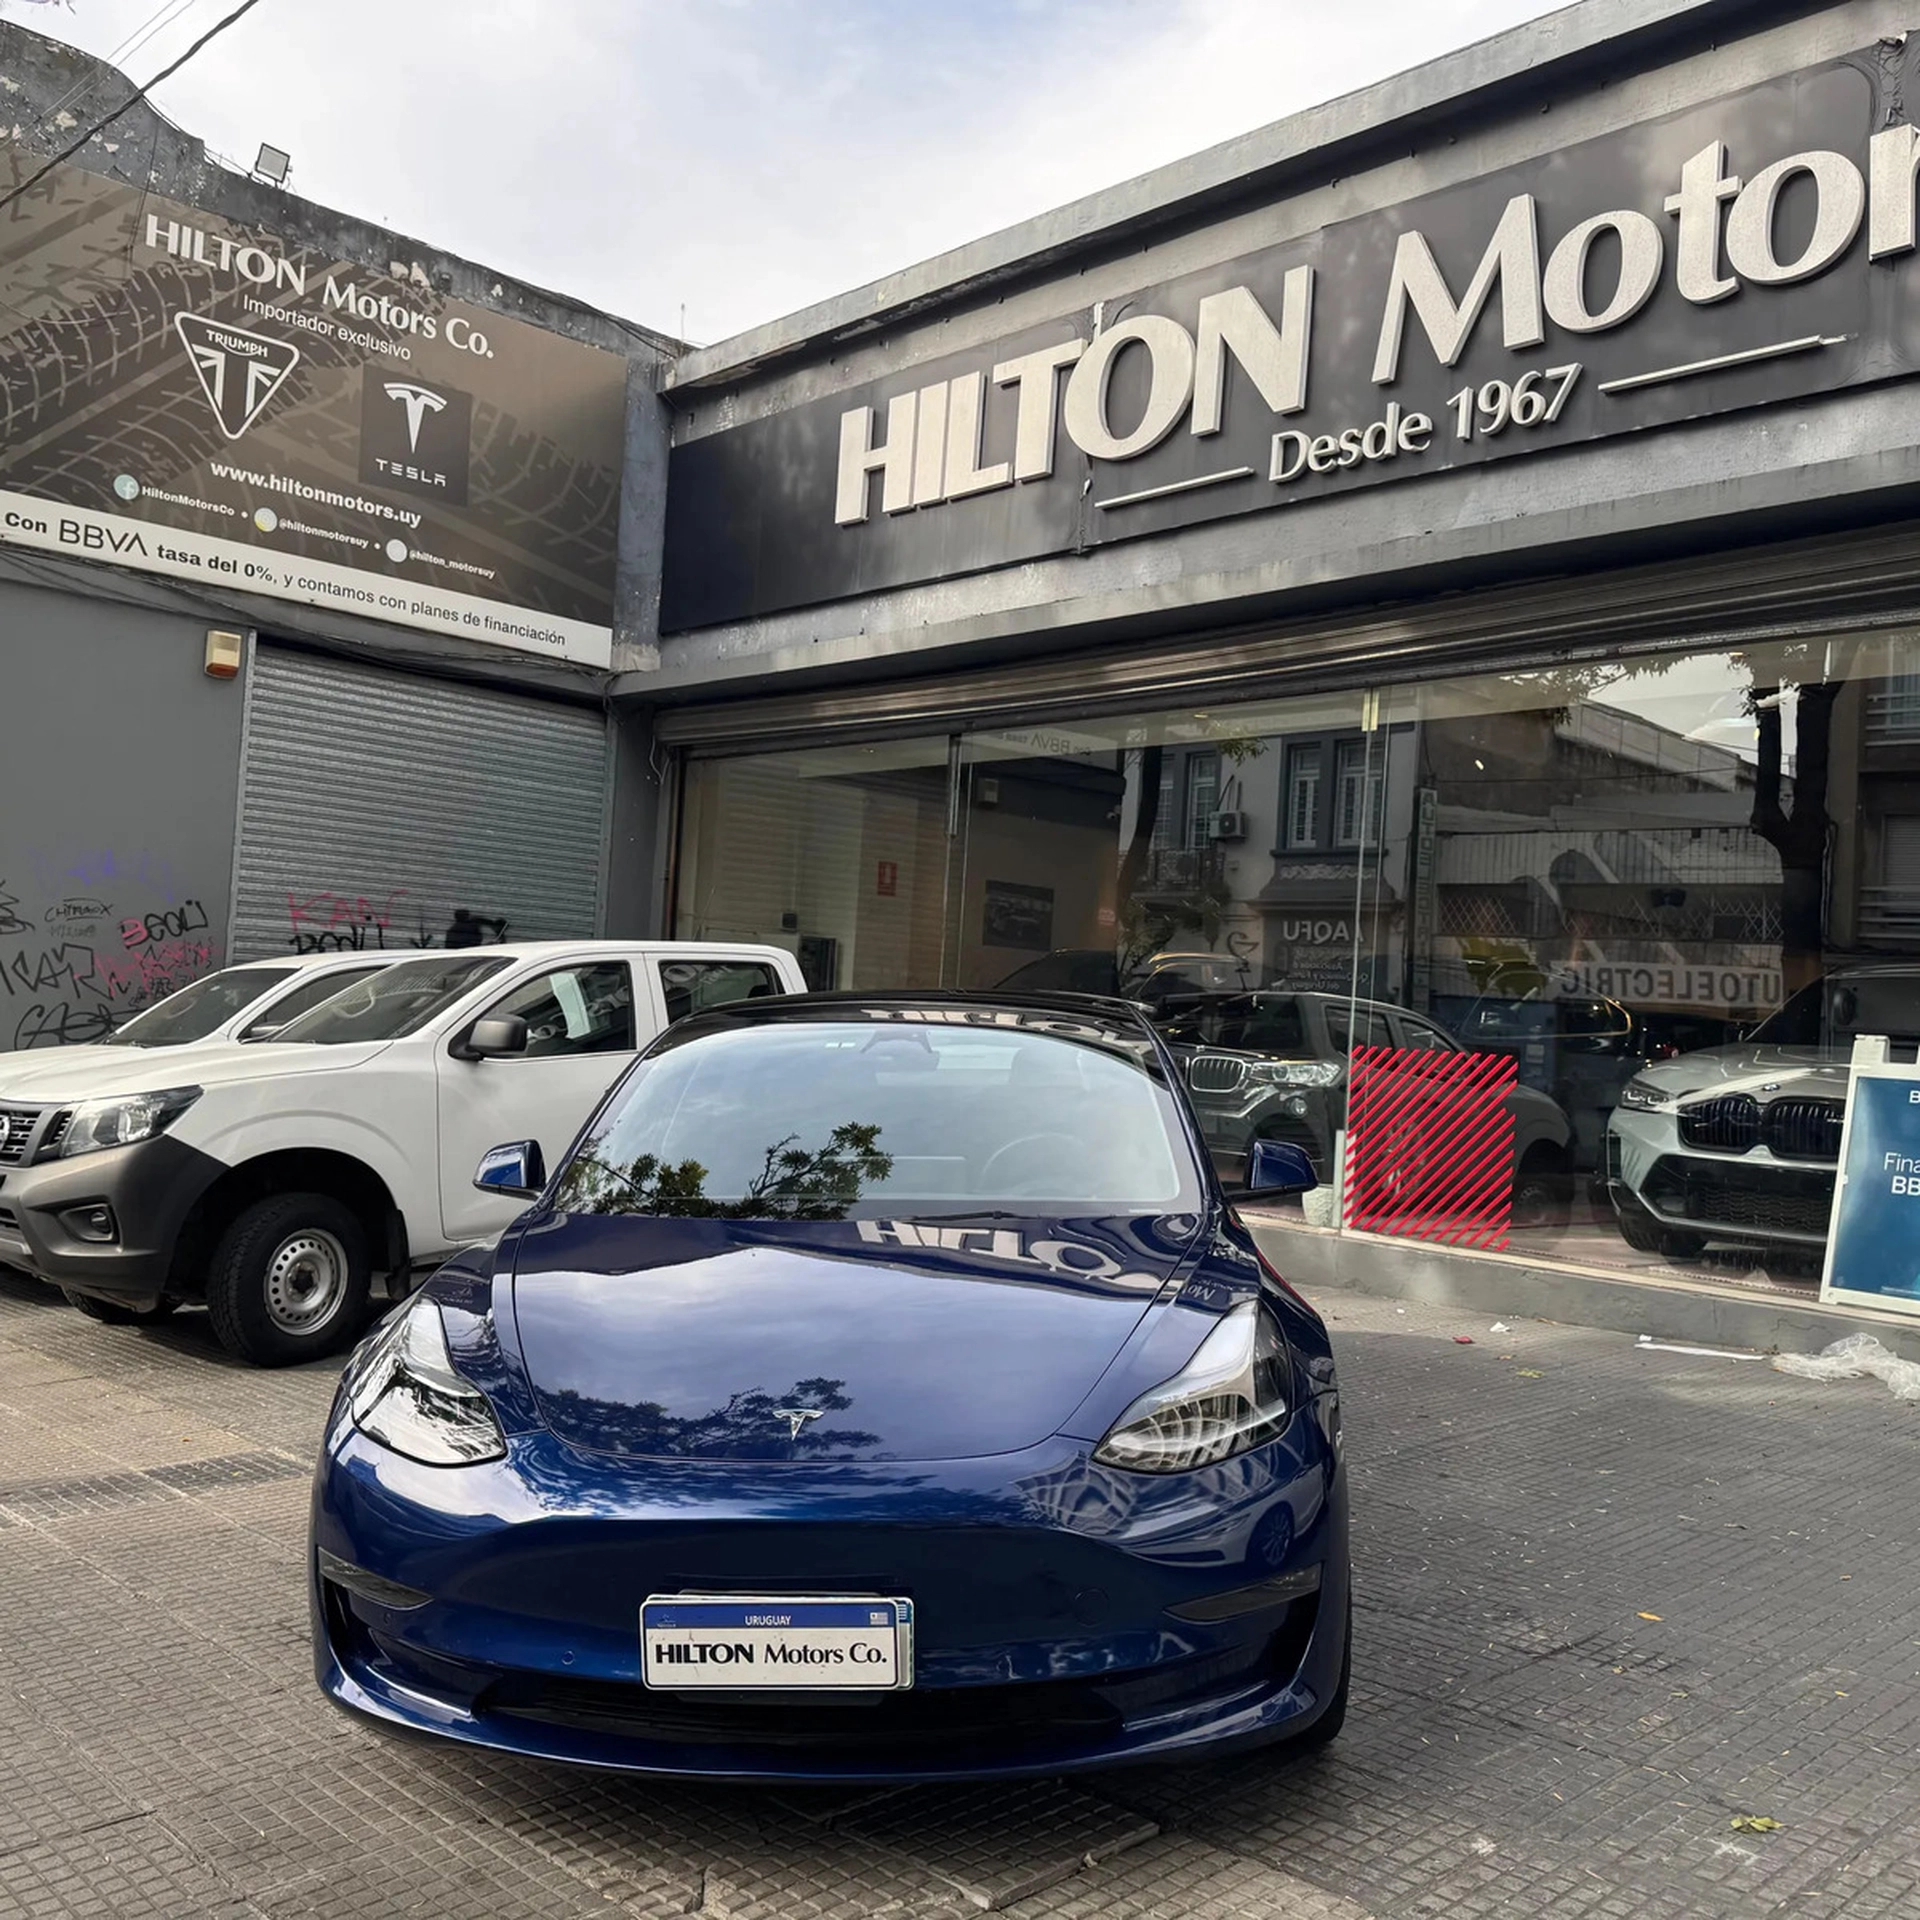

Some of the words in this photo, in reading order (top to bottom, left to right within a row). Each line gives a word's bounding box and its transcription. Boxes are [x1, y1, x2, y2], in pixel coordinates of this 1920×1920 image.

[145, 213, 306, 296] HILTON
[322, 275, 437, 339] Motors
[445, 316, 495, 360] Co.
[206, 329, 268, 358] TRIUMPH
[243, 294, 335, 337] Importador
[337, 326, 411, 361] exclusivo
[833, 263, 1314, 526] HILTON
[1371, 123, 1920, 386] Motor
[1268, 400, 1433, 483] Desde
[1446, 362, 1583, 441] 1967
[210, 462, 422, 529] www.hiltonmotors.uy
[375, 457, 447, 488] TESLA
[141, 485, 236, 517] HiltonMotorsCo
[278, 517, 369, 549] @hiltonmotorsuy
[4, 511, 48, 534] Con
[59, 518, 149, 557] BBVA
[156, 543, 202, 568] tasa
[207, 555, 238, 575] del
[244, 563, 278, 585] 0%,
[284, 573, 294, 588] y
[297, 575, 375, 604] contamos
[378, 593, 407, 611] con
[410, 600, 459, 623] planes
[463, 611, 481, 627] de
[484, 616, 567, 646] financiación
[745, 1615, 792, 1626] URUGUAY
[655, 1643, 754, 1665] HILTON
[764, 1643, 844, 1665] Motors
[849, 1642, 888, 1665] Co.
